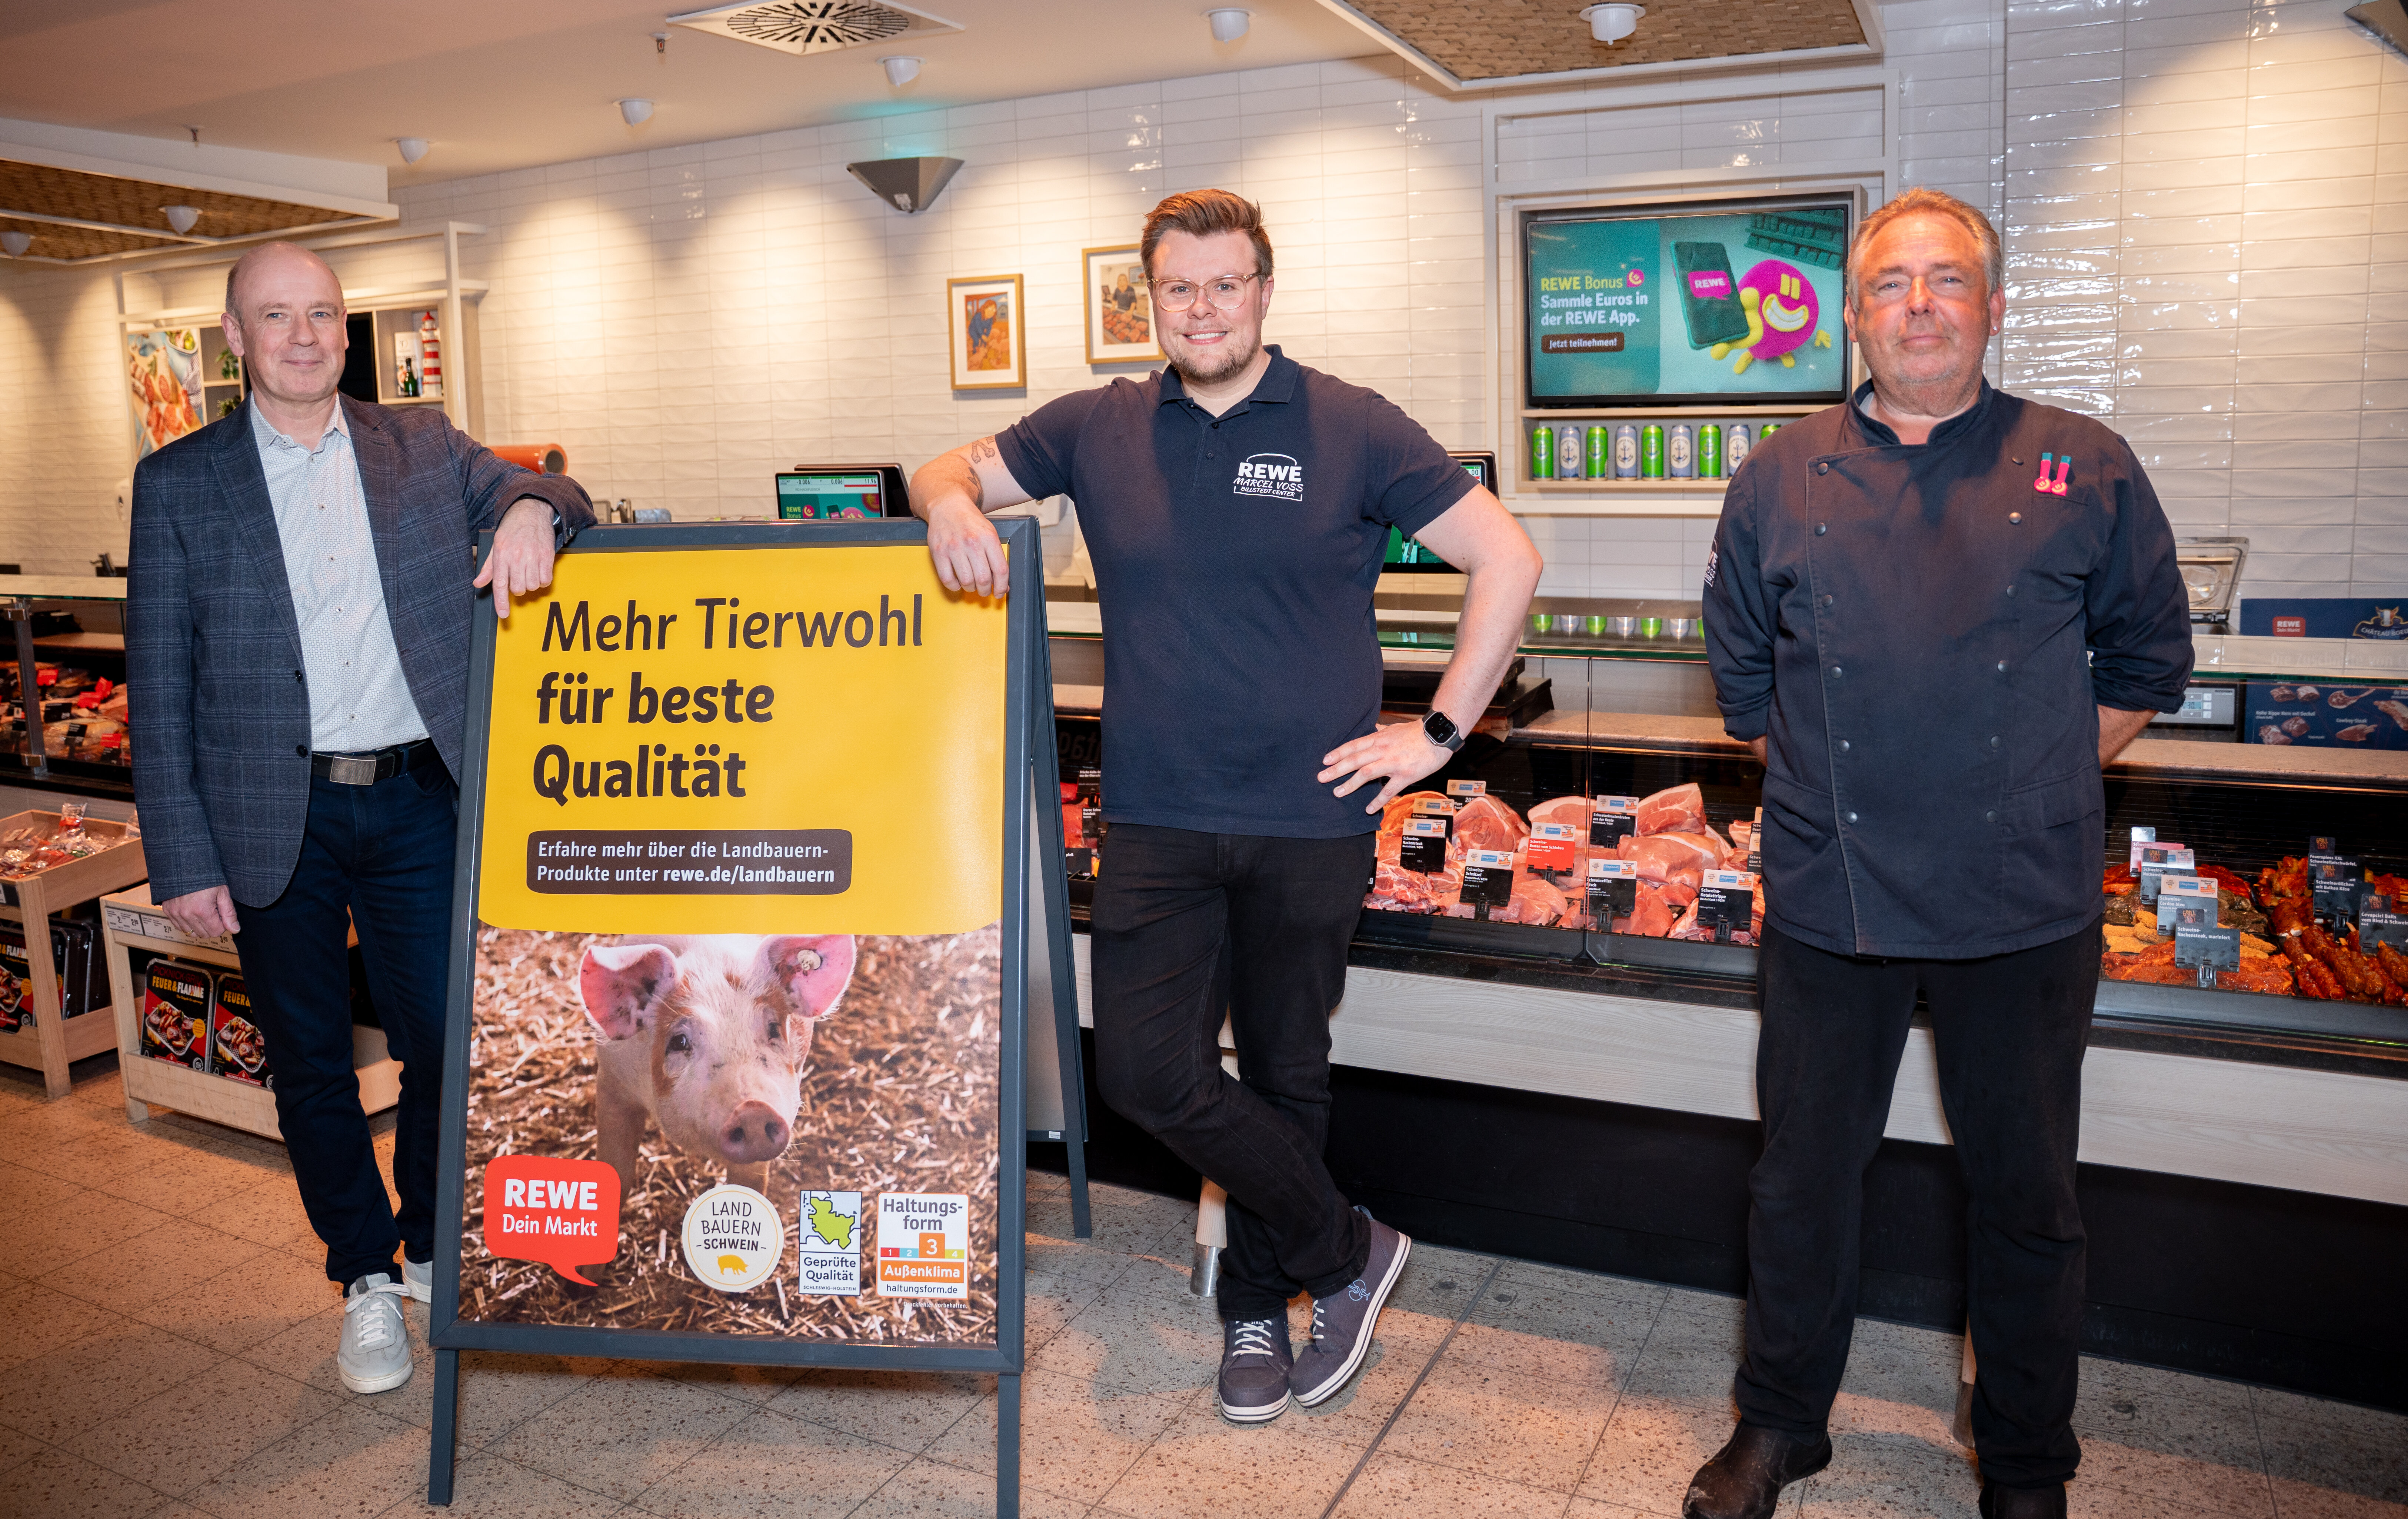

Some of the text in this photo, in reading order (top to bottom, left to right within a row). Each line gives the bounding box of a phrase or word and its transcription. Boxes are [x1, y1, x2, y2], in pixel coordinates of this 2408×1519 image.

[1541, 276, 1623, 291] REWE Bonus
[1694, 278, 1725, 288] REWE
[1541, 291, 1648, 309] Sammle Euros in
[1541, 310, 1640, 326] der REWE App.
[1569, 338, 1617, 347] teilnehmen!
[1238, 462, 1302, 482] REWE
[1233, 477, 1303, 492] MARCEL VOSS
[542, 594, 922, 652] Mehr Tierwohl
[537, 672, 775, 724] für beste
[533, 743, 746, 806] Qualität
[538, 842, 828, 858] Erfahre mehr über die Landbauern-
[537, 865, 835, 884] Produkte unter rewe.de/landbauern
[504, 1179, 597, 1210] REWE
[712, 1202, 752, 1216] LAND
[884, 1198, 963, 1217] Haltungs-
[503, 1213, 597, 1236] Dein Markt
[701, 1219, 761, 1236] BAUERN
[903, 1215, 942, 1230] form
[926, 1239, 937, 1255] 3
[804, 1257, 856, 1270] Geprüfte
[806, 1270, 854, 1282] Qualität
[885, 1265, 960, 1279] Außenklima
[886, 1284, 957, 1294] haltungsform.de
